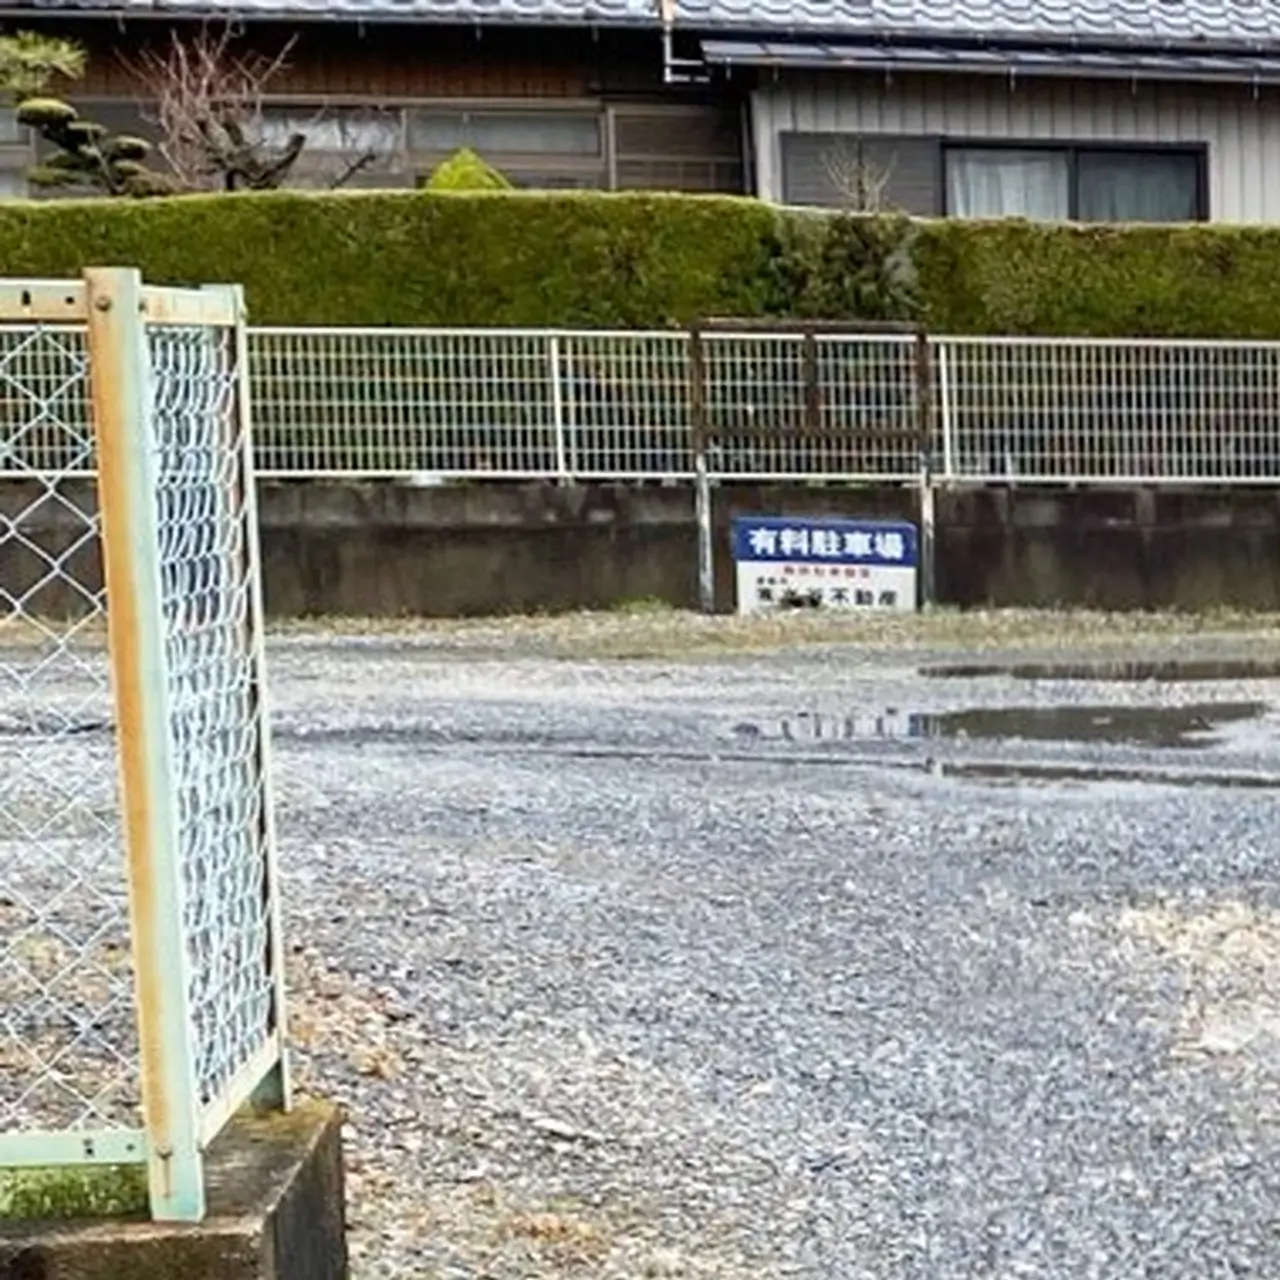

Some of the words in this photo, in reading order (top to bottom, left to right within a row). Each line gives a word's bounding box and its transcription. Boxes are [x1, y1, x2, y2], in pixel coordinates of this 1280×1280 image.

[750, 526, 904, 559] 有料駐車場
